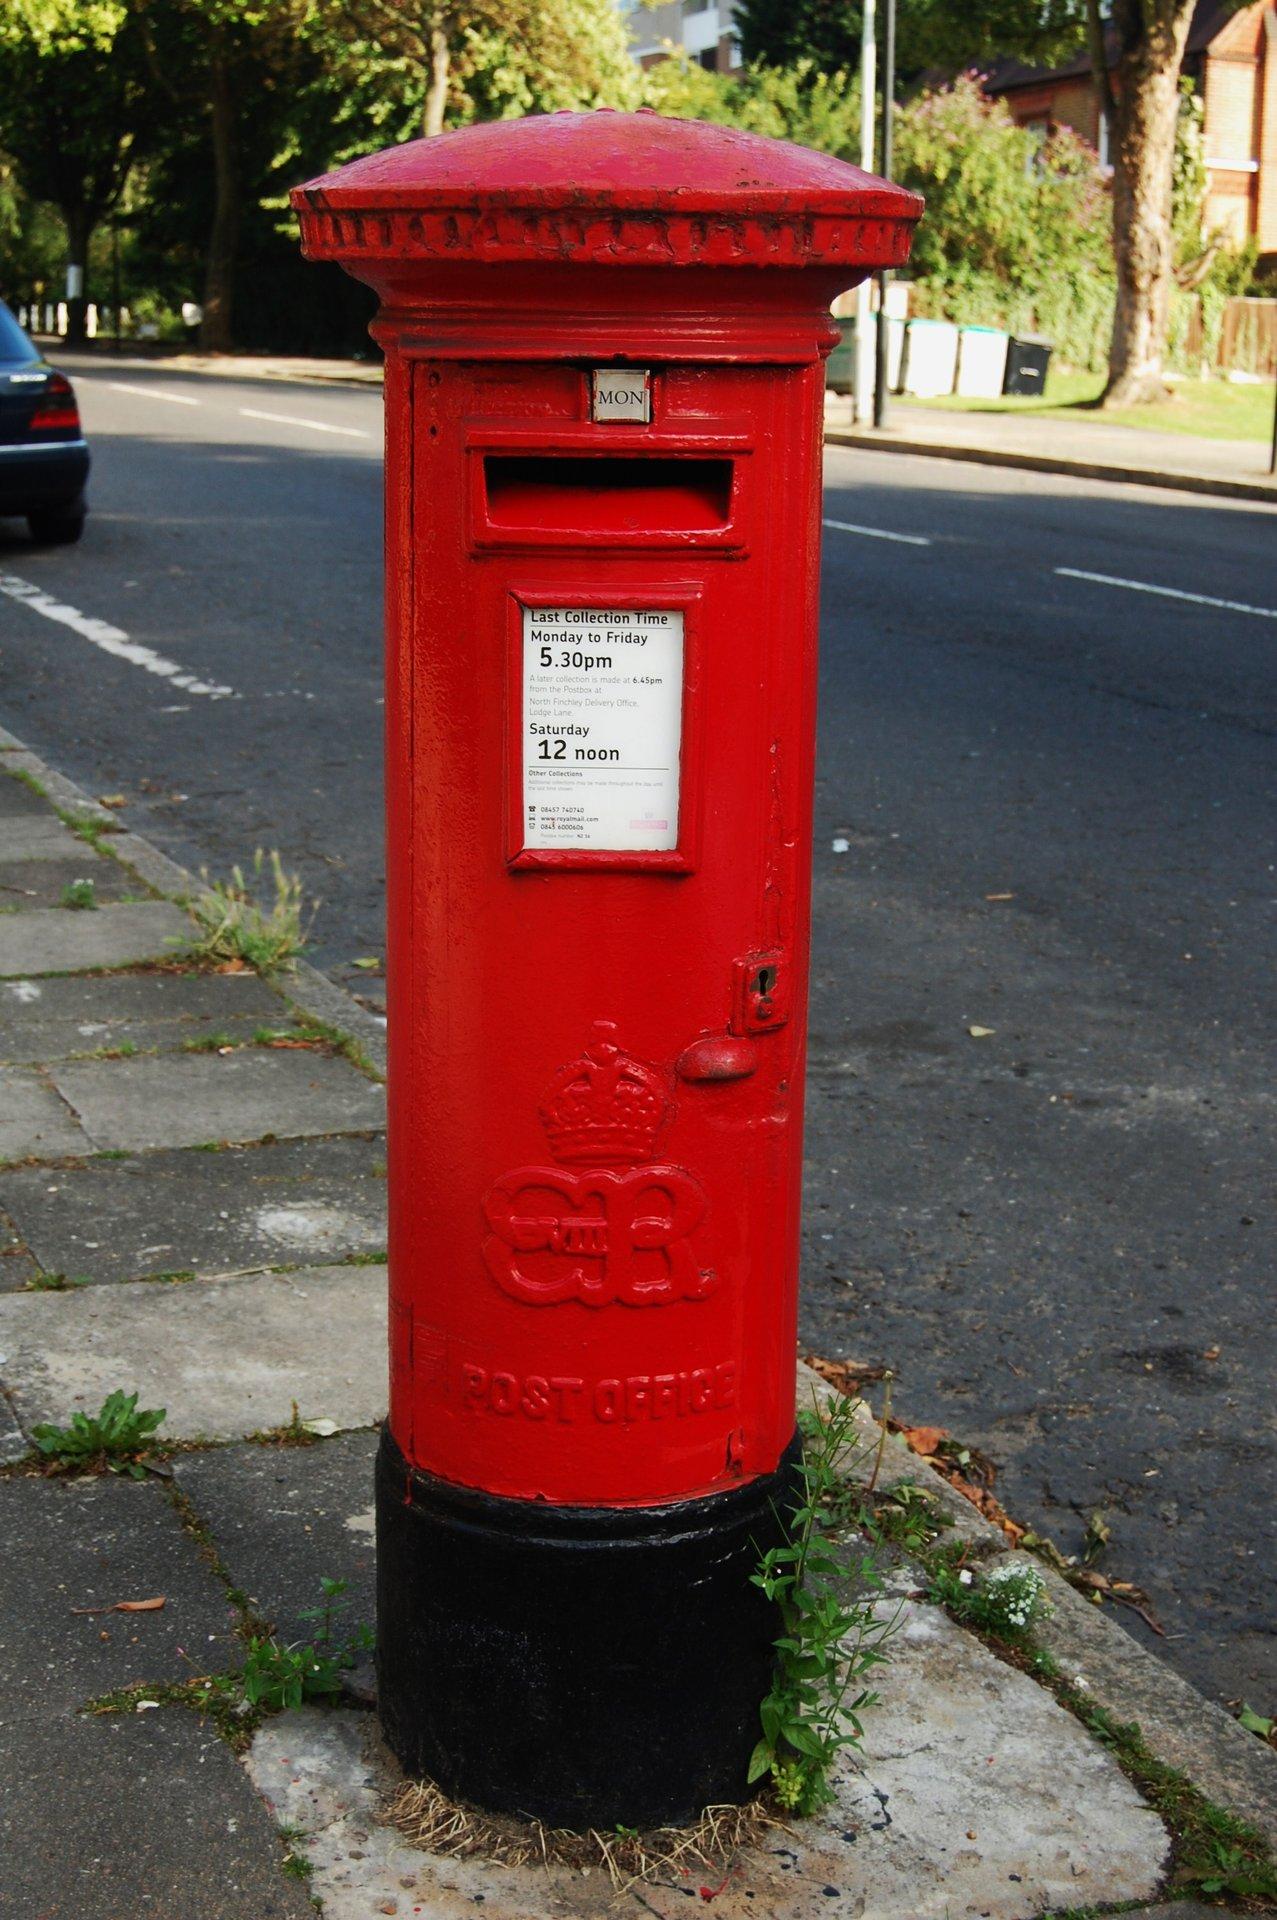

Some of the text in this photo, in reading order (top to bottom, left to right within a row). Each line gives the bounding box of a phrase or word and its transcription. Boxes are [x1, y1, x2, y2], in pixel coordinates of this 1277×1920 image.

[598, 390, 645, 405] MON
[531, 611, 668, 625] Last Collection Time
[531, 630, 648, 646] Monday to Friday
[540, 646, 613, 671] 5.30pm
[529, 674, 663, 685] A later collection is made at 6.45pm
[529, 685, 548, 693] from
[549, 685, 562, 694] the
[563, 685, 592, 694] Postbox
[529, 697, 551, 706] North
[553, 697, 583, 707] Finchley
[585, 698, 615, 708] Delivery
[529, 708, 552, 717] Lodge
[529, 723, 590, 738] Saturday
[538, 739, 620, 761] 12 noon
[548, 770, 583, 778] Collections
[462, 1360, 737, 1424] POST OFFICE
